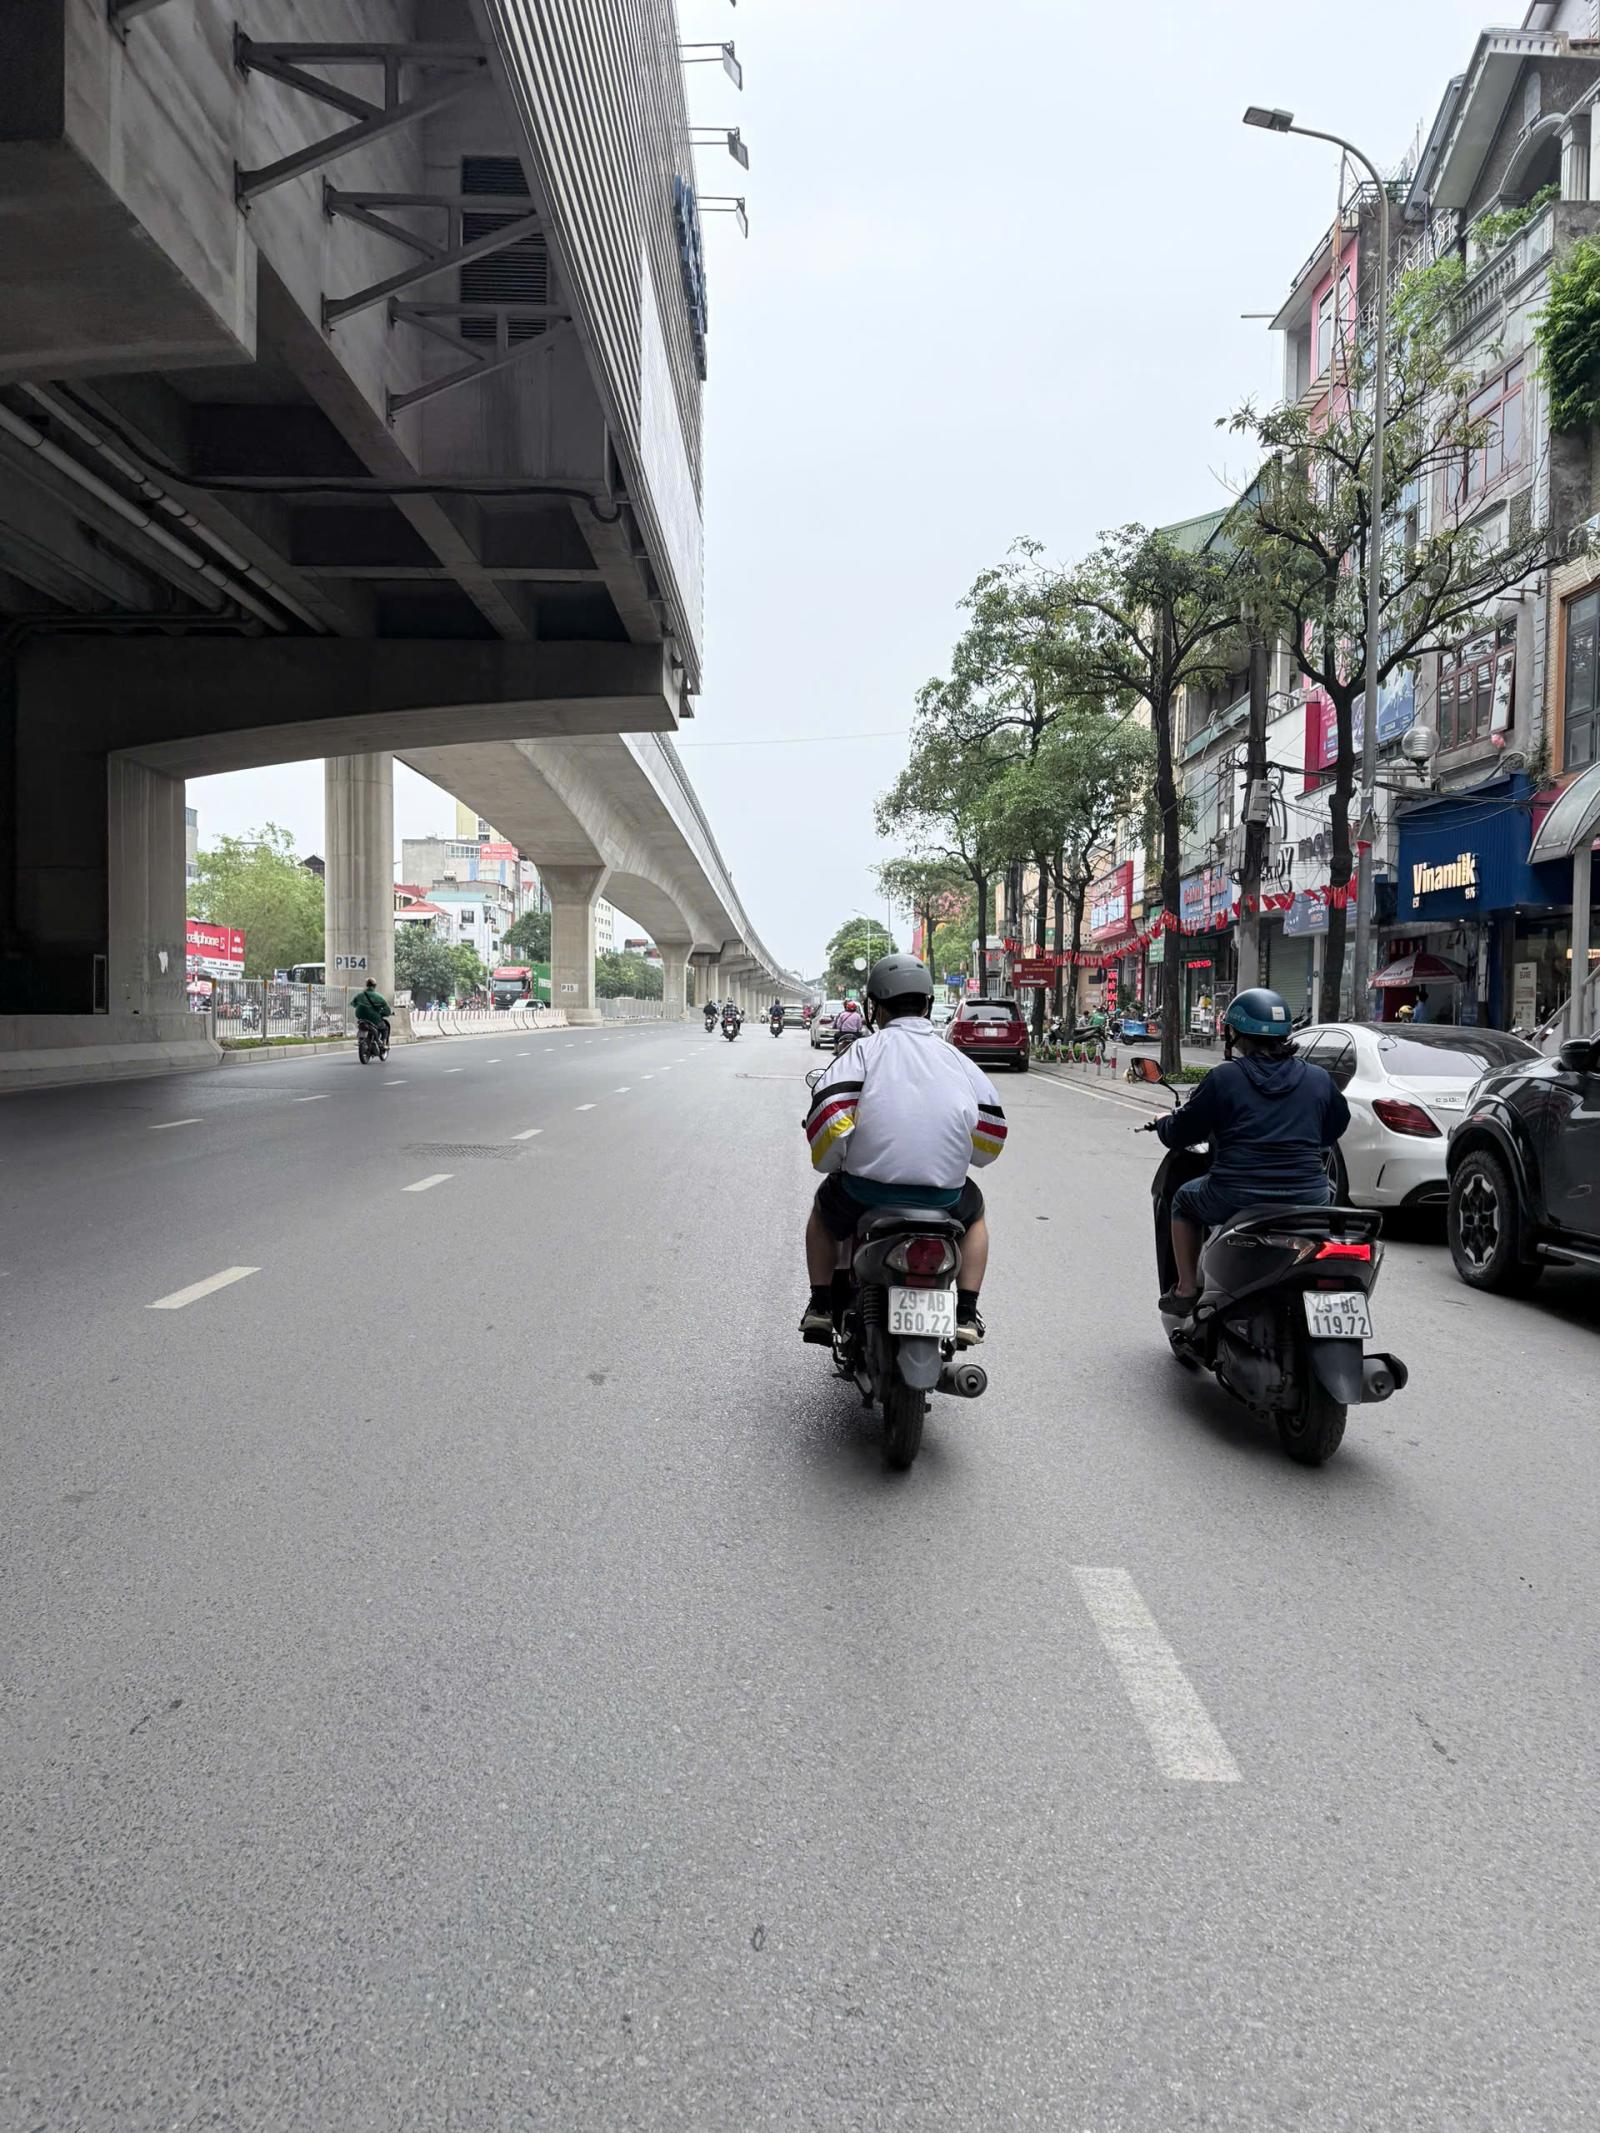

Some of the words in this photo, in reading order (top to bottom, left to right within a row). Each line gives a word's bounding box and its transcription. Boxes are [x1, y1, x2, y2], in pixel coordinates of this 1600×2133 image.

[1413, 852, 1477, 895] Vinamilk
[336, 956, 367, 970] P154
[898, 1290, 946, 1312] 29-AB
[892, 1311, 952, 1335] 360.22
[1313, 1315, 1369, 1336] 119.72
